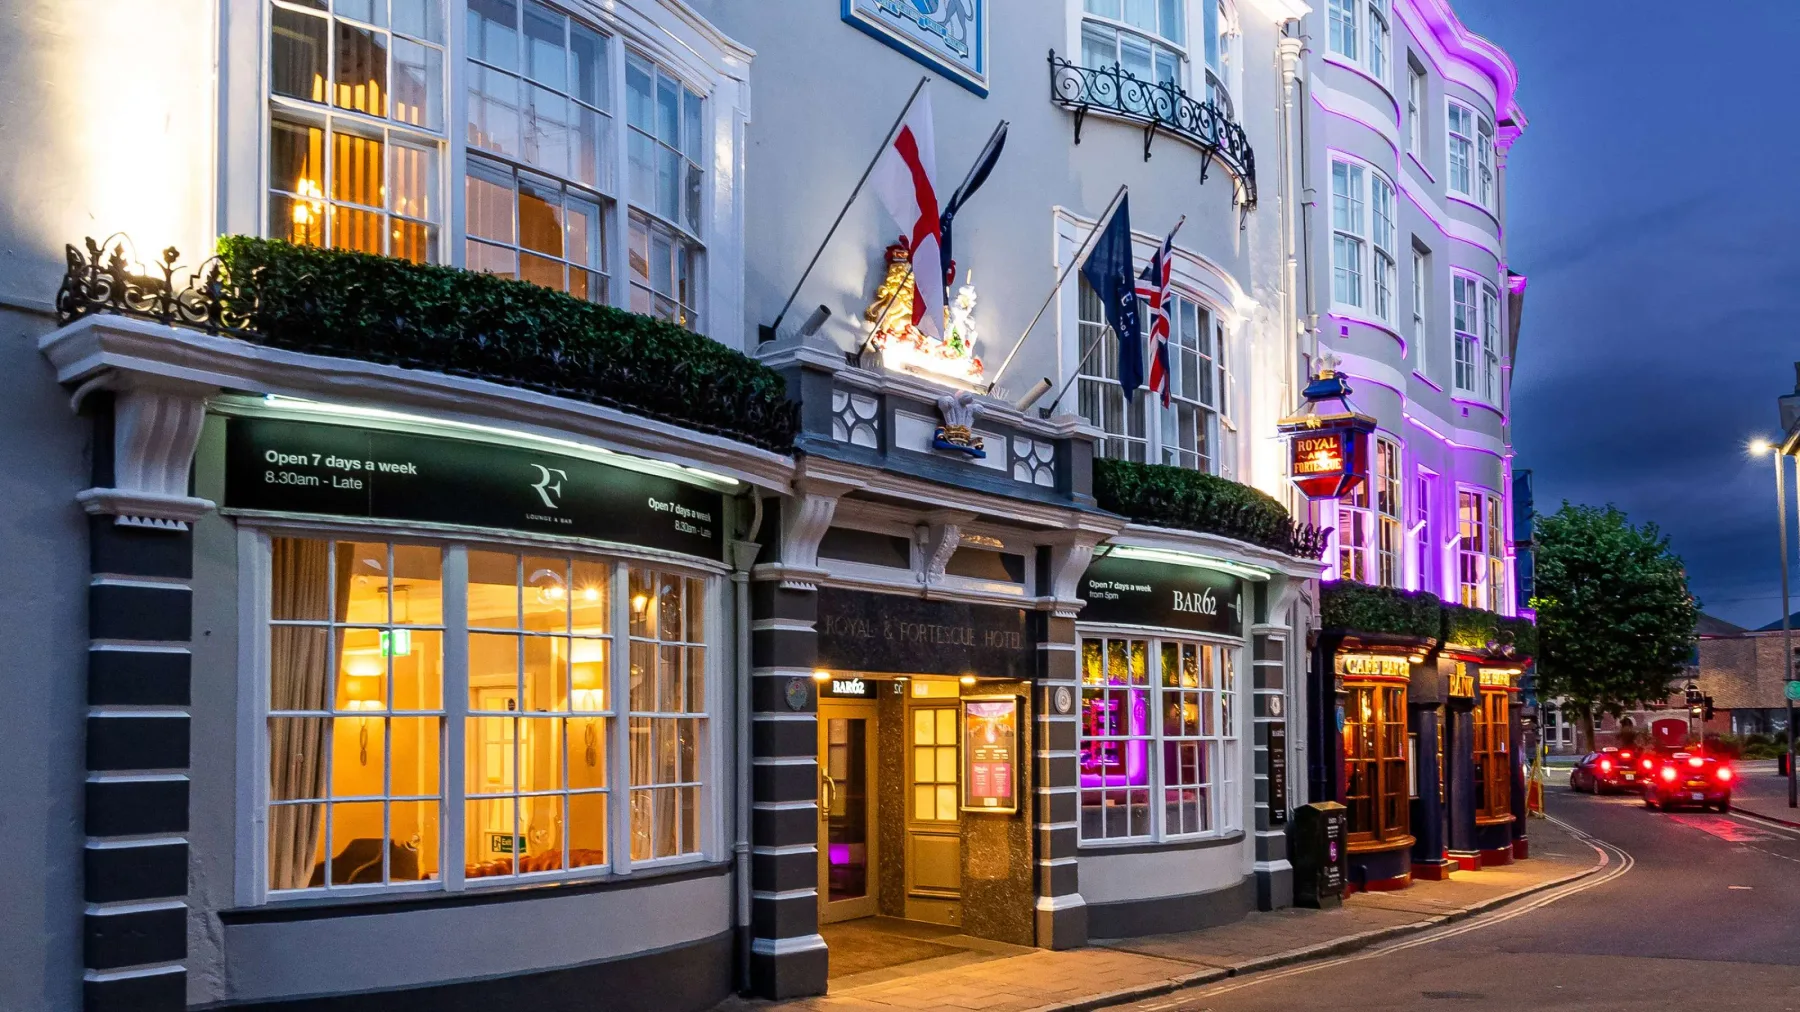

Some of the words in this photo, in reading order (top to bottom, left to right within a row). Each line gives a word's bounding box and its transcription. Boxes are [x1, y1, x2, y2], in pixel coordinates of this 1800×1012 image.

[1297, 437, 1338, 452] ROYAL
[265, 450, 308, 466] Open
[311, 453, 322, 466] 7
[325, 455, 362, 471] days
[364, 460, 375, 471] a
[377, 461, 418, 475] week
[1294, 458, 1343, 474] FORTEUE
[265, 470, 319, 486] 8.30am
[332, 475, 363, 489] Late
[648, 497, 669, 511] Open
[669, 502, 675, 513] 7
[675, 503, 691, 518] days
[691, 510, 697, 518] a
[696, 512, 712, 523] week
[560, 517, 573, 525] BAR
[674, 519, 698, 534] 8.30am
[1089, 580, 1108, 590] Open
[1108, 581, 1113, 589] 7
[1114, 583, 1130, 592] days
[1135, 584, 1152, 593] week
[1089, 591, 1104, 599] from
[1104, 591, 1119, 600] 5pm
[1172, 586, 1217, 616] BAR62
[825, 614, 876, 639] ROYAL
[882, 620, 894, 640] &
[900, 621, 976, 647] FORTESCUE
[984, 630, 1023, 650] HOTEL
[832, 678, 865, 694] BAR62
[1448, 673, 1476, 698] BANK
